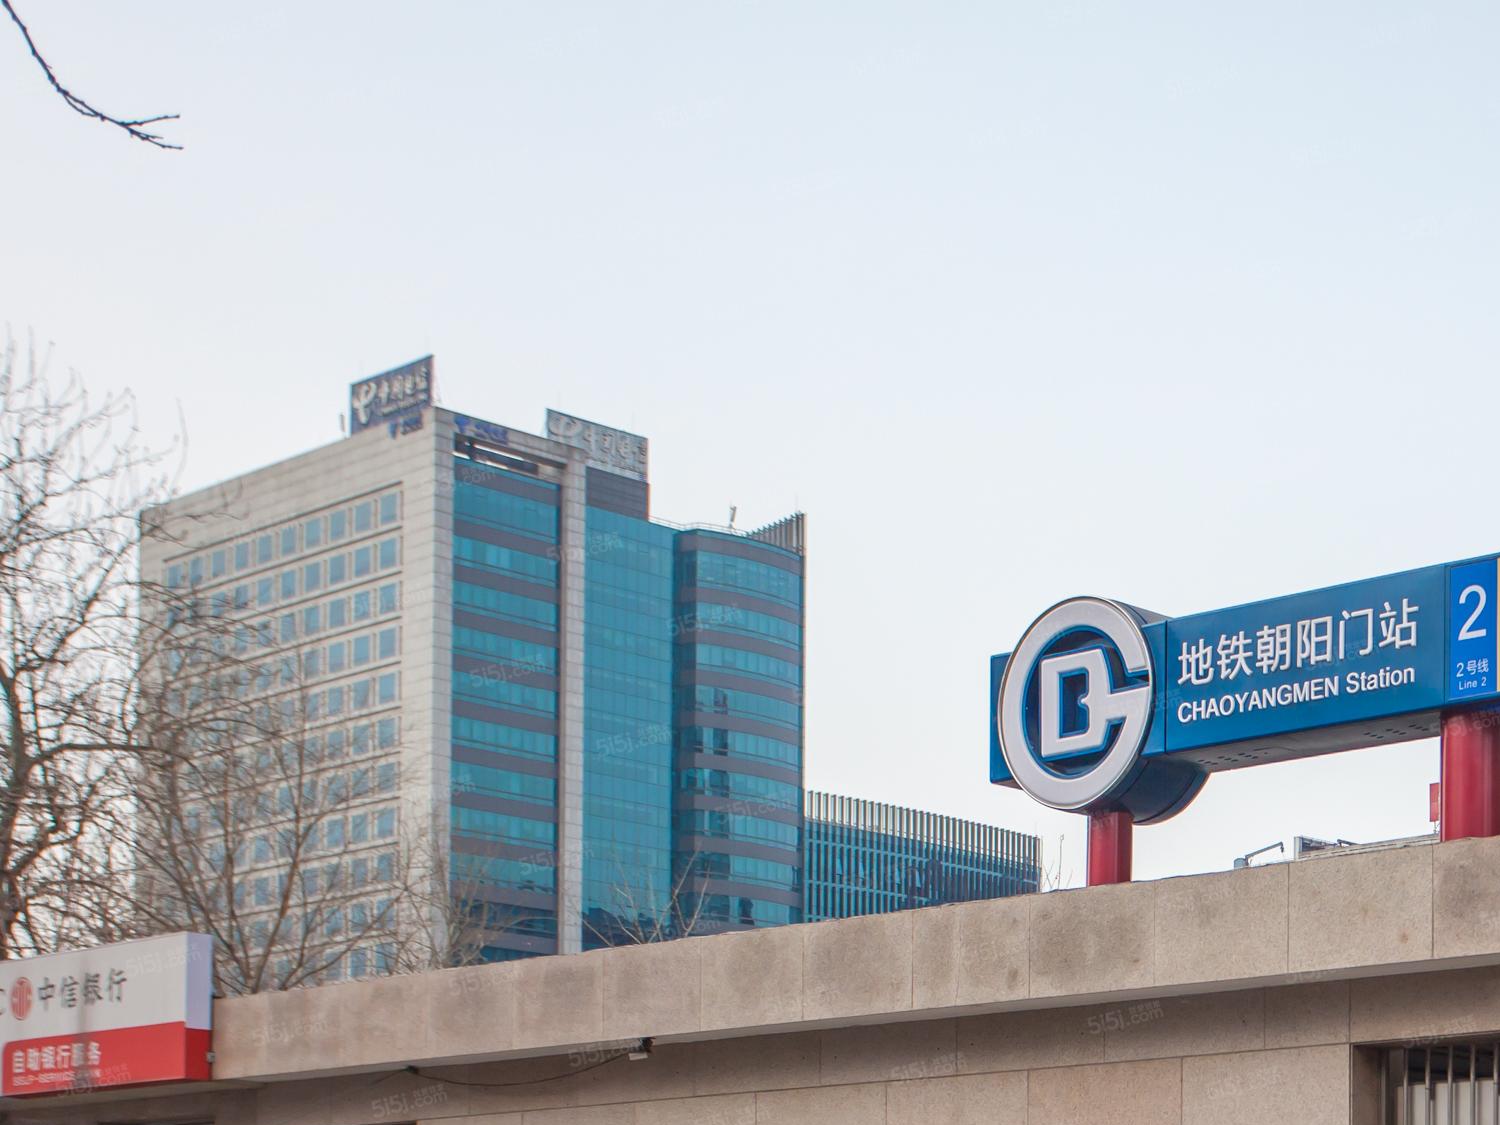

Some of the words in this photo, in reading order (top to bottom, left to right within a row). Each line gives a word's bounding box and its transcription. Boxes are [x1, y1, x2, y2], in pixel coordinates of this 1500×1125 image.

[1457, 584, 1487, 641] 2
[1177, 598, 1419, 686] 地铁朝阳门站
[1456, 658, 1489, 678] 2号线
[1458, 679, 1478, 691] Line
[1481, 676, 1487, 687] 2
[1177, 676, 1339, 724] CHAOYANGMEN
[1346, 666, 1416, 694] Station
[38, 968, 128, 1010] 中信银行
